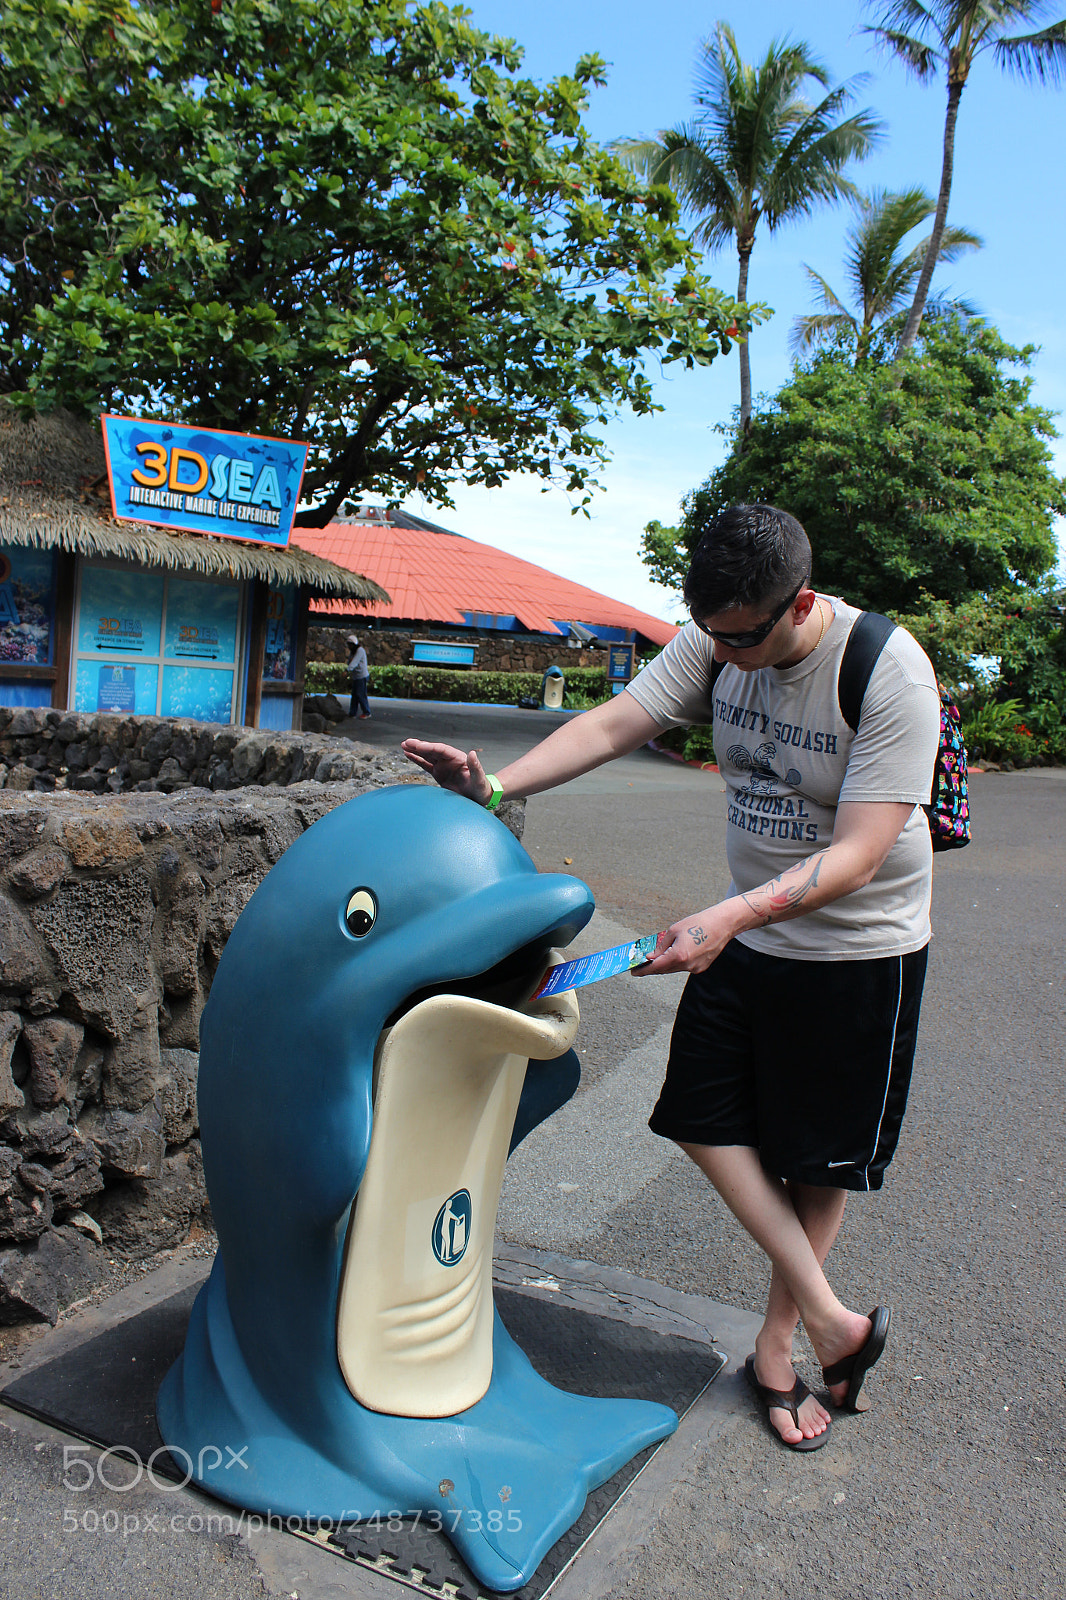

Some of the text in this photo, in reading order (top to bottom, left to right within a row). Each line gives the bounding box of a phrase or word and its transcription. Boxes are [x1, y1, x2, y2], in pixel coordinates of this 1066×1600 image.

[131, 441, 282, 509] 3D SEA
[130, 486, 281, 527] INTERACTIVE MARINE LIFE EXPERIENCE
[98, 617, 120, 631] 3D
[179, 626, 198, 638] 3D
[715, 698, 838, 755] TRINITY SQUASH
[727, 804, 819, 842] CHAMPIONS
[733, 789, 809, 819] NATIONAL
